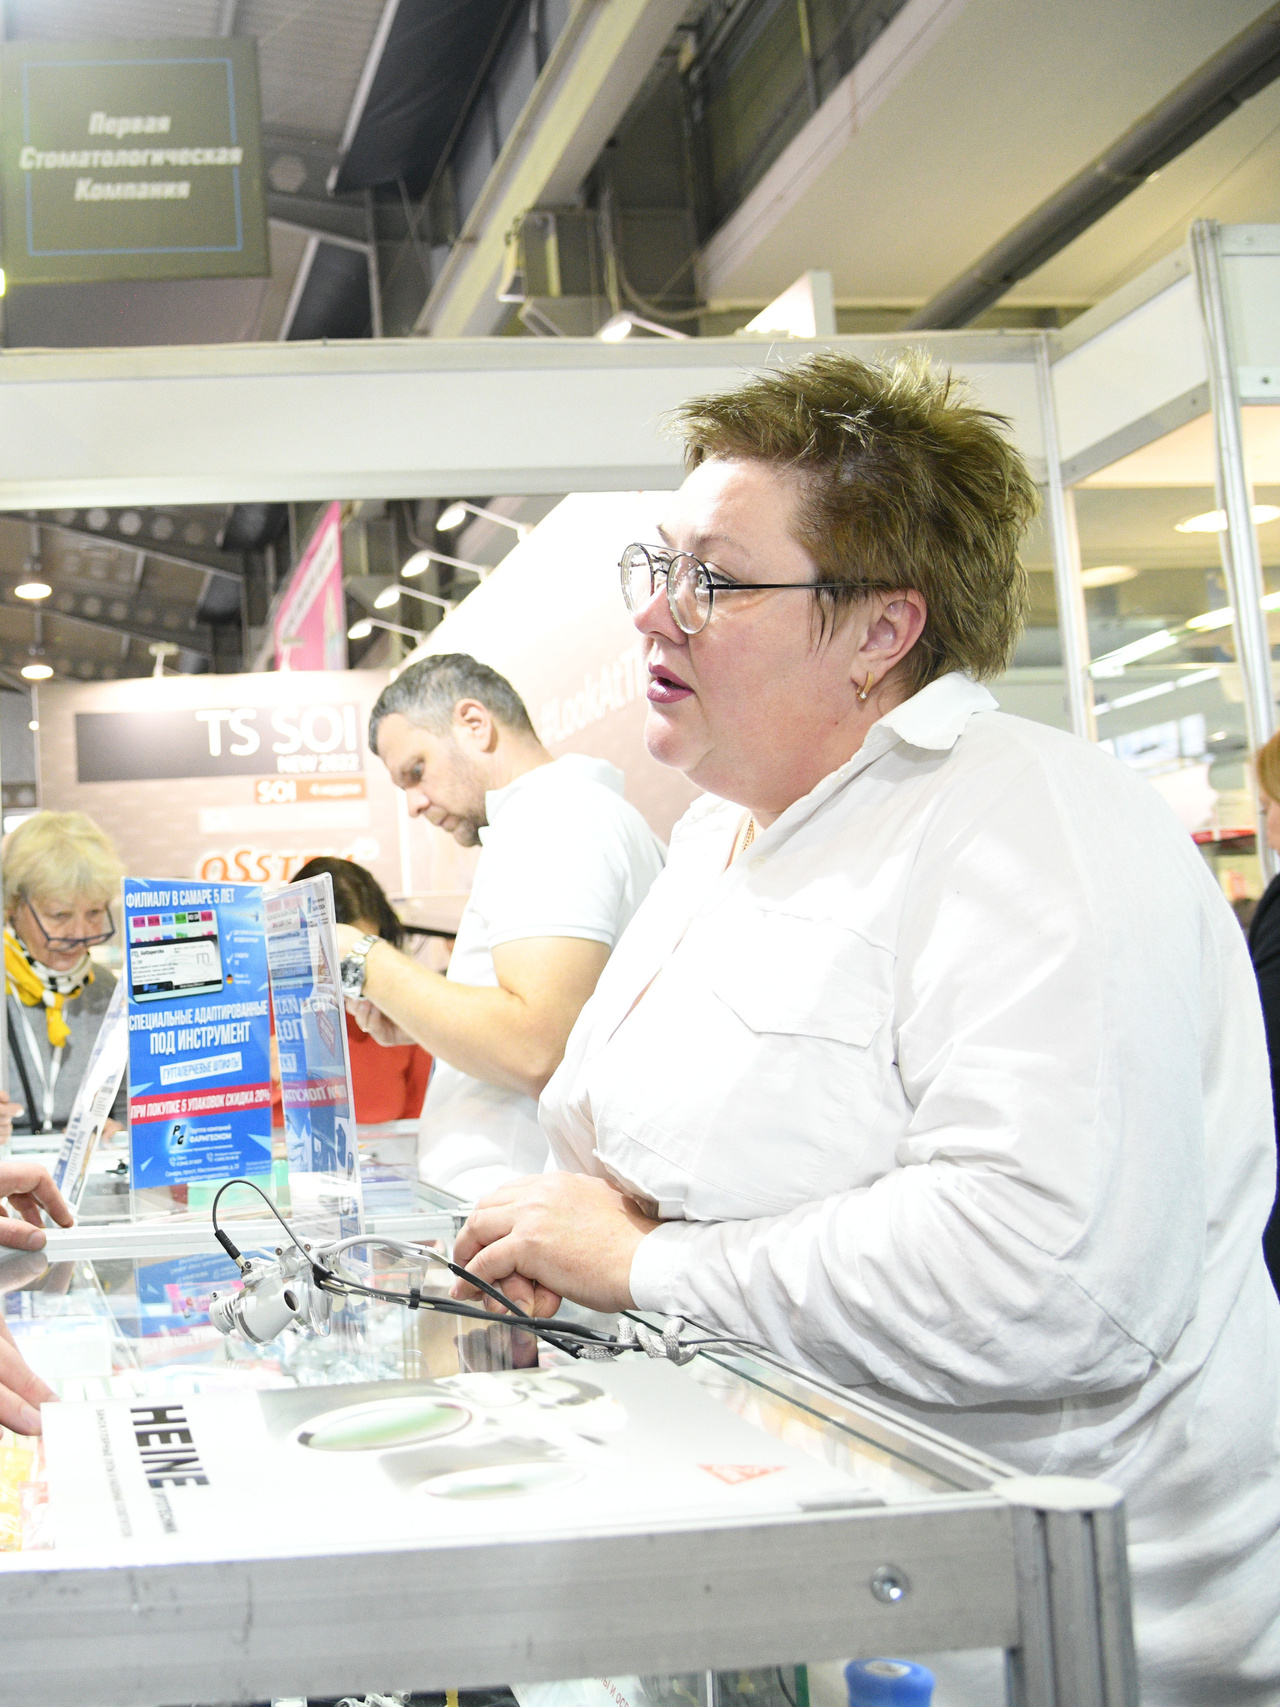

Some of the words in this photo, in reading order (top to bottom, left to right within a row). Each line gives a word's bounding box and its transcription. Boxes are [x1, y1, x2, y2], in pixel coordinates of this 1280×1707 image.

[88, 111, 172, 138] Первая
[20, 146, 244, 170] Стоматологическая
[74, 178, 191, 201] Компания
[195, 707, 261, 757] TS
[270, 704, 358, 755] SOI
[257, 779, 297, 803] SOI
[126, 891, 171, 908] ФИЛИАЛУ
[172, 890, 179, 907] В
[180, 888, 213, 906] САМАРЕ
[213, 888, 219, 904] 5
[219, 888, 235, 904] ЛЕТ
[129, 1008, 193, 1031] СПЕЦИАЛЬНЫЕ
[194, 1000, 268, 1024] АДАПТИРОВАННЫЕ
[150, 1031, 176, 1055] ПОД
[178, 1021, 251, 1051] ИНСТРУМЕНТ
[130, 1103, 147, 1119] ПРИ
[147, 1099, 180, 1117] ПОКУПКЕ
[181, 1098, 187, 1113] 5
[187, 1094, 226, 1112] УПАКОВОК
[226, 1091, 254, 1107] СКИДКА
[130, 1405, 210, 1488] HEINE
